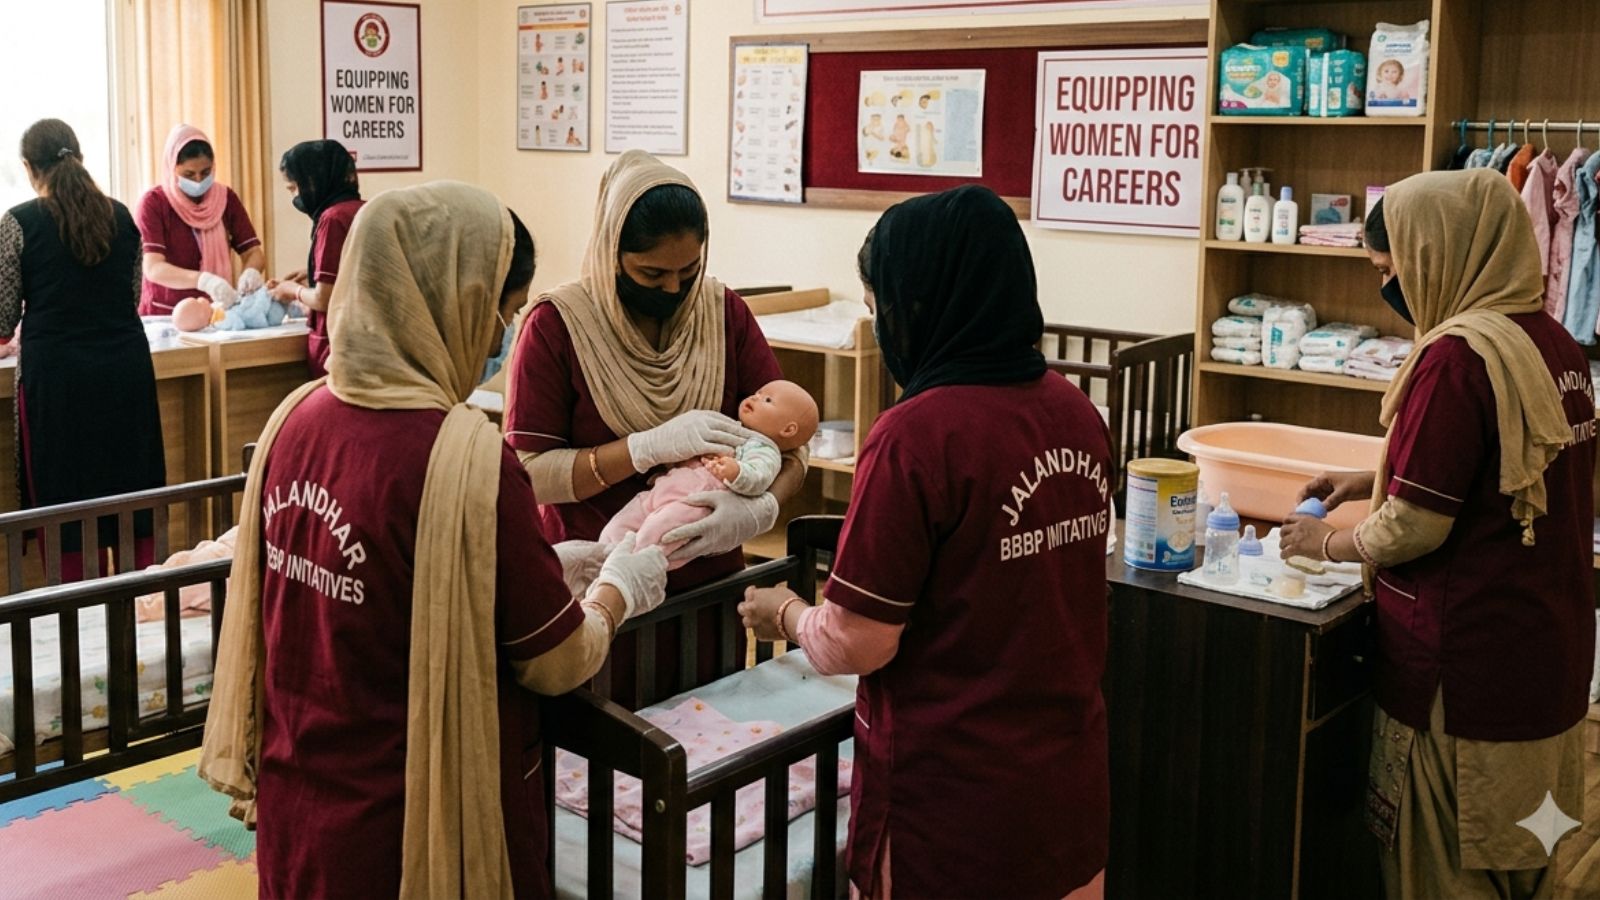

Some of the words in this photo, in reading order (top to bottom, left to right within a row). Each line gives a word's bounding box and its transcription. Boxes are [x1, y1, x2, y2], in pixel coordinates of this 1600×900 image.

[336, 69, 409, 90] EQUIPPING
[1056, 75, 1196, 114] EQUIPPING
[330, 94, 384, 114] WOMEN
[388, 95, 415, 114] FOR
[342, 119, 405, 139] CAREERS
[1049, 122, 1142, 157] WOMEN
[1150, 123, 1200, 159] FOR
[1062, 167, 1182, 207] CAREERS
[1000, 529, 1044, 561] BBBP
